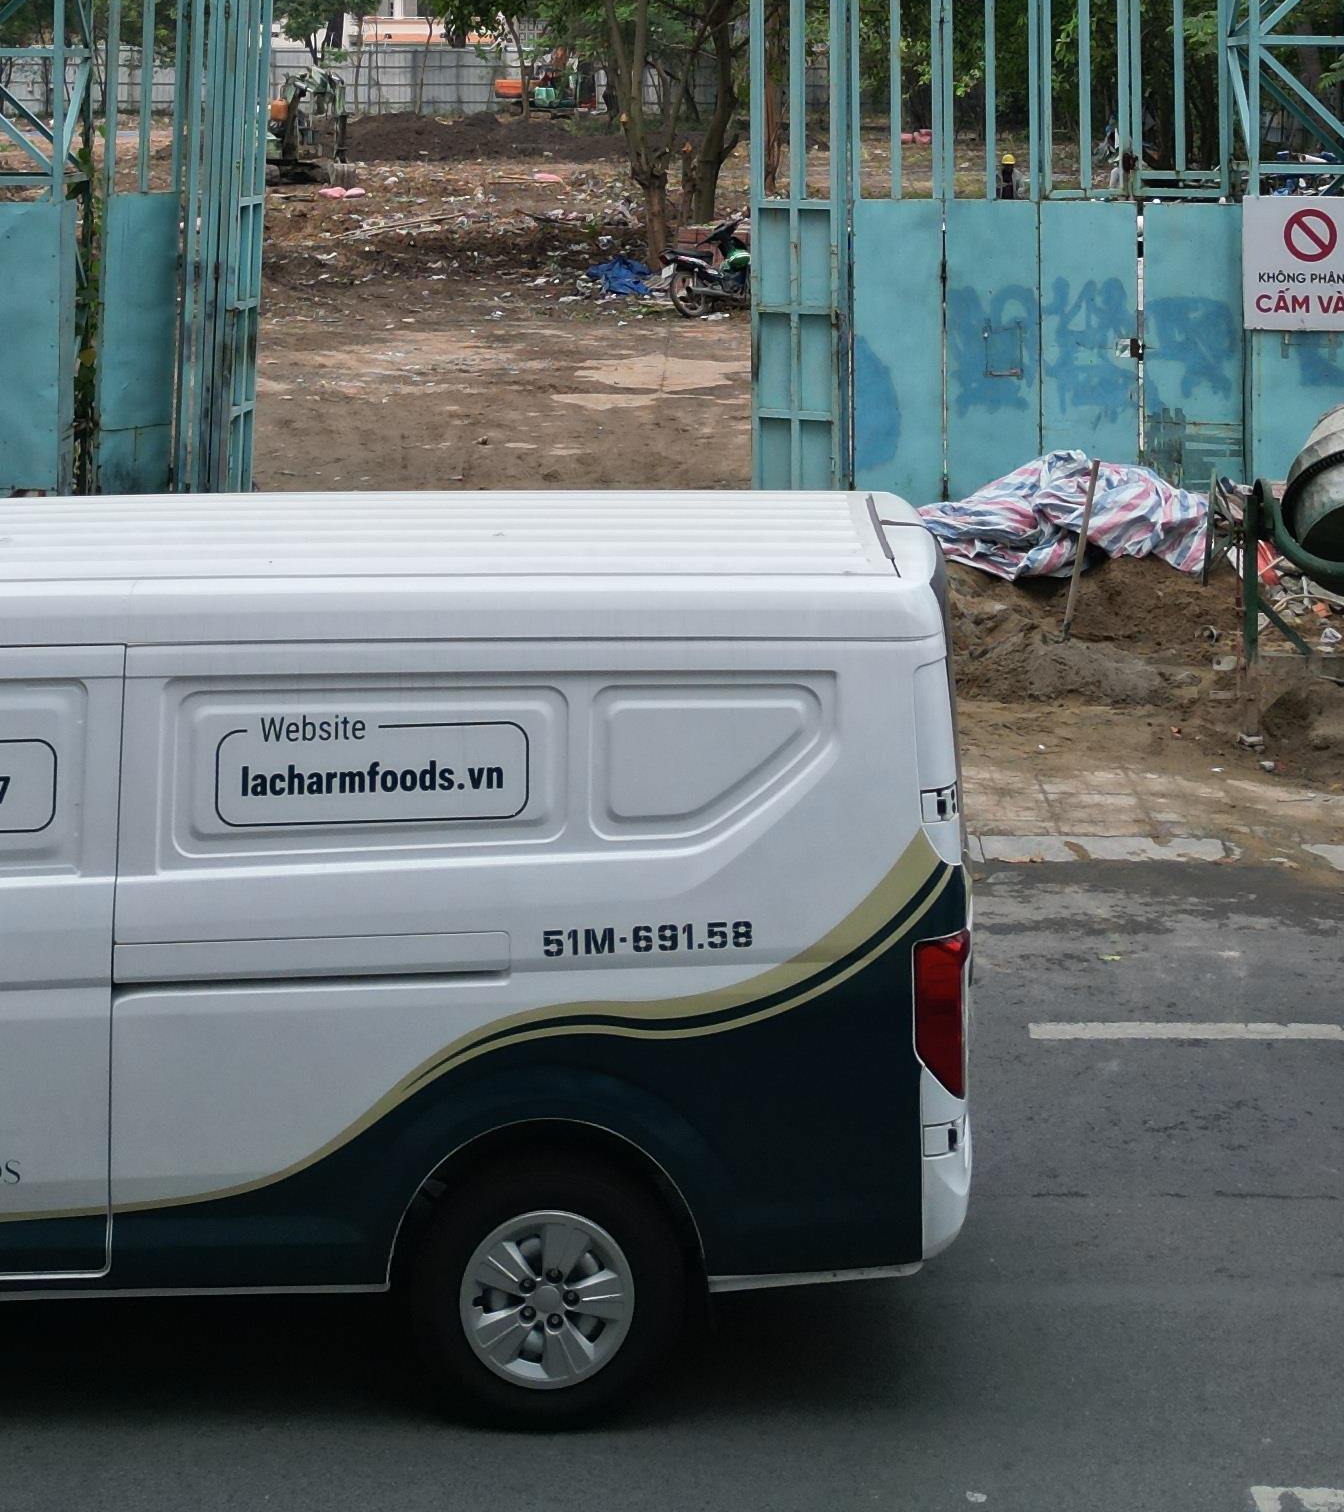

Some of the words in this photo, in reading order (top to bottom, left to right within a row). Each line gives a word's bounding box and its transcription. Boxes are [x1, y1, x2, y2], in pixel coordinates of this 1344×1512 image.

[1258, 270, 1306, 284] KHÔNG
[1256, 288, 1310, 313] CẤM
[260, 714, 367, 744] Website
[241, 760, 505, 798] lacharmfoods.vn
[543, 920, 754, 958] 51M-691.58
